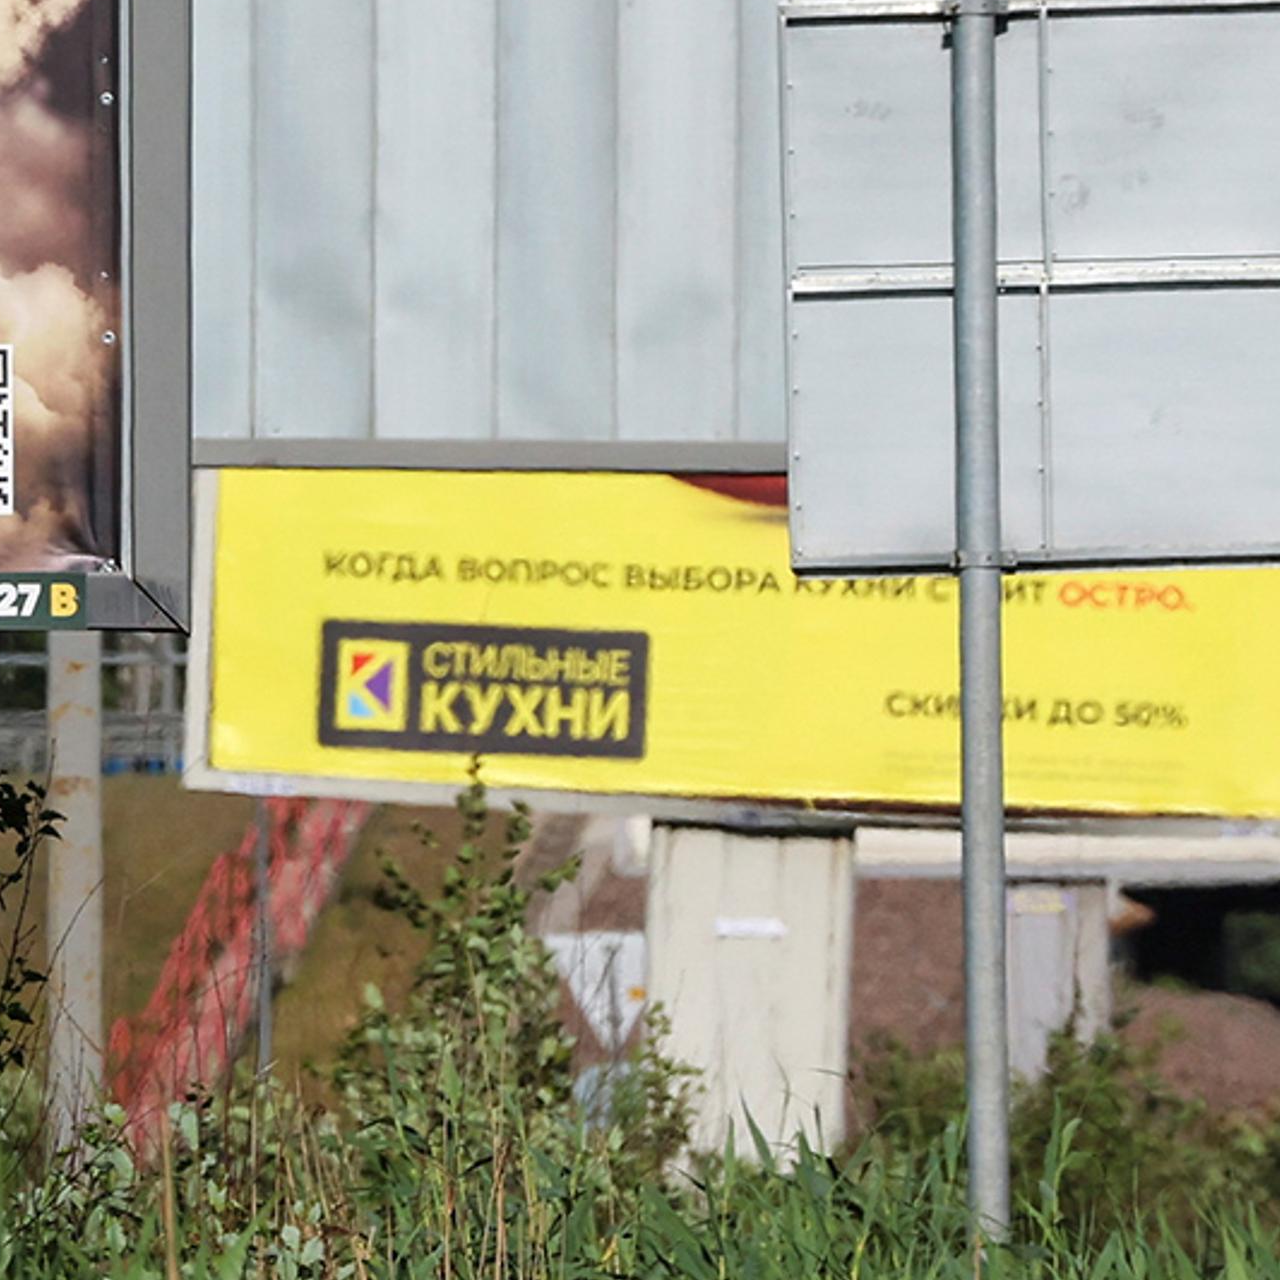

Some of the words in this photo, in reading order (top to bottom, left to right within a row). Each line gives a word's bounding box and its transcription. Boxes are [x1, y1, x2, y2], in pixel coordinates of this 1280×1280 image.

[323, 549, 444, 584] КОГДА
[456, 554, 614, 589] ВОПРОС
[625, 562, 782, 594] ВЫБОРА
[926, 576, 1048, 604] СИТ
[1057, 580, 1196, 612] ОСТРО.
[422, 640, 633, 686] СТИЛЬНЫЕ
[419, 681, 630, 742] КУХНИ
[1046, 697, 1104, 727] ДО
